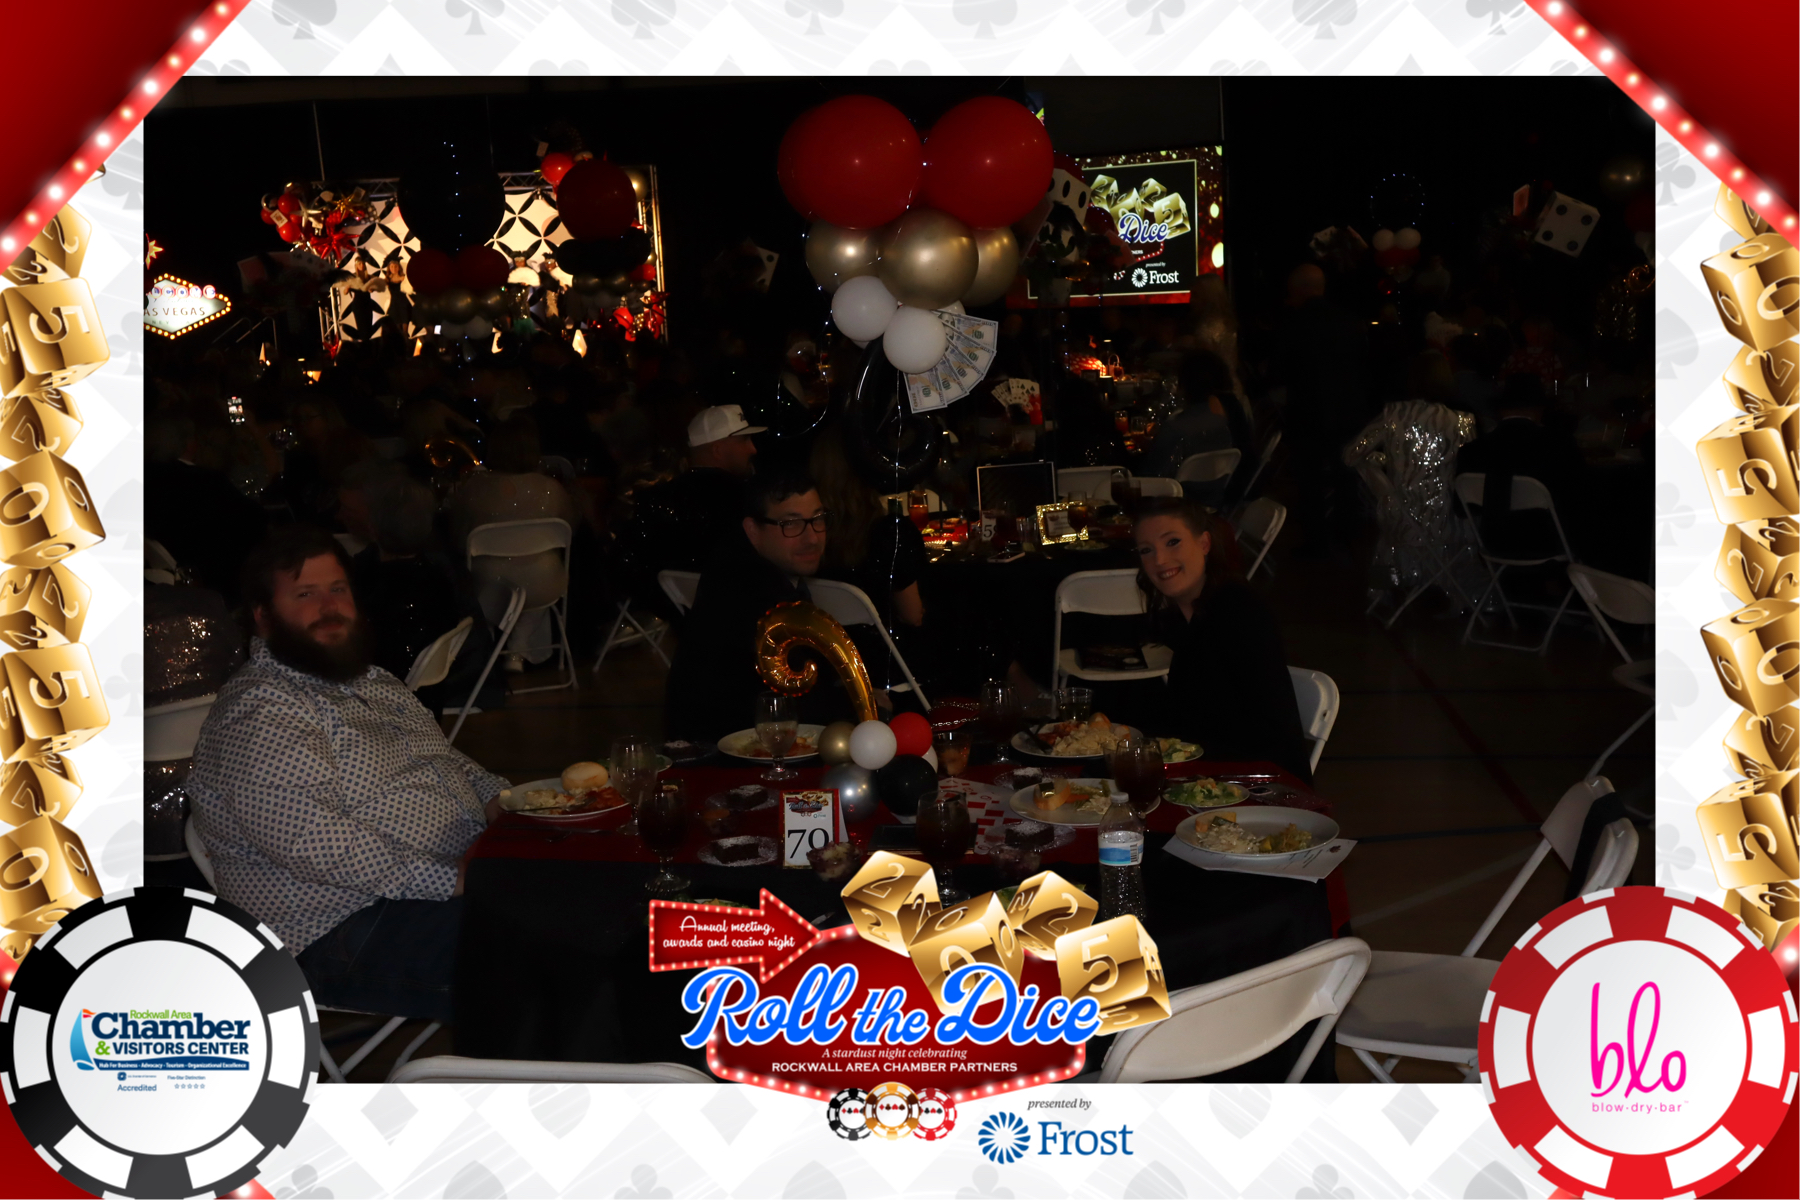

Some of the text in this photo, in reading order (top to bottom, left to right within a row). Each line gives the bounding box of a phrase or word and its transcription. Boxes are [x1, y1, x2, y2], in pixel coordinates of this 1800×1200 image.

[1161, 200, 1175, 223] 5
[1118, 212, 1169, 243] Dice
[1149, 270, 1179, 284] Frost
[143, 307, 205, 316] AS VEGAS
[787, 827, 830, 859] 70
